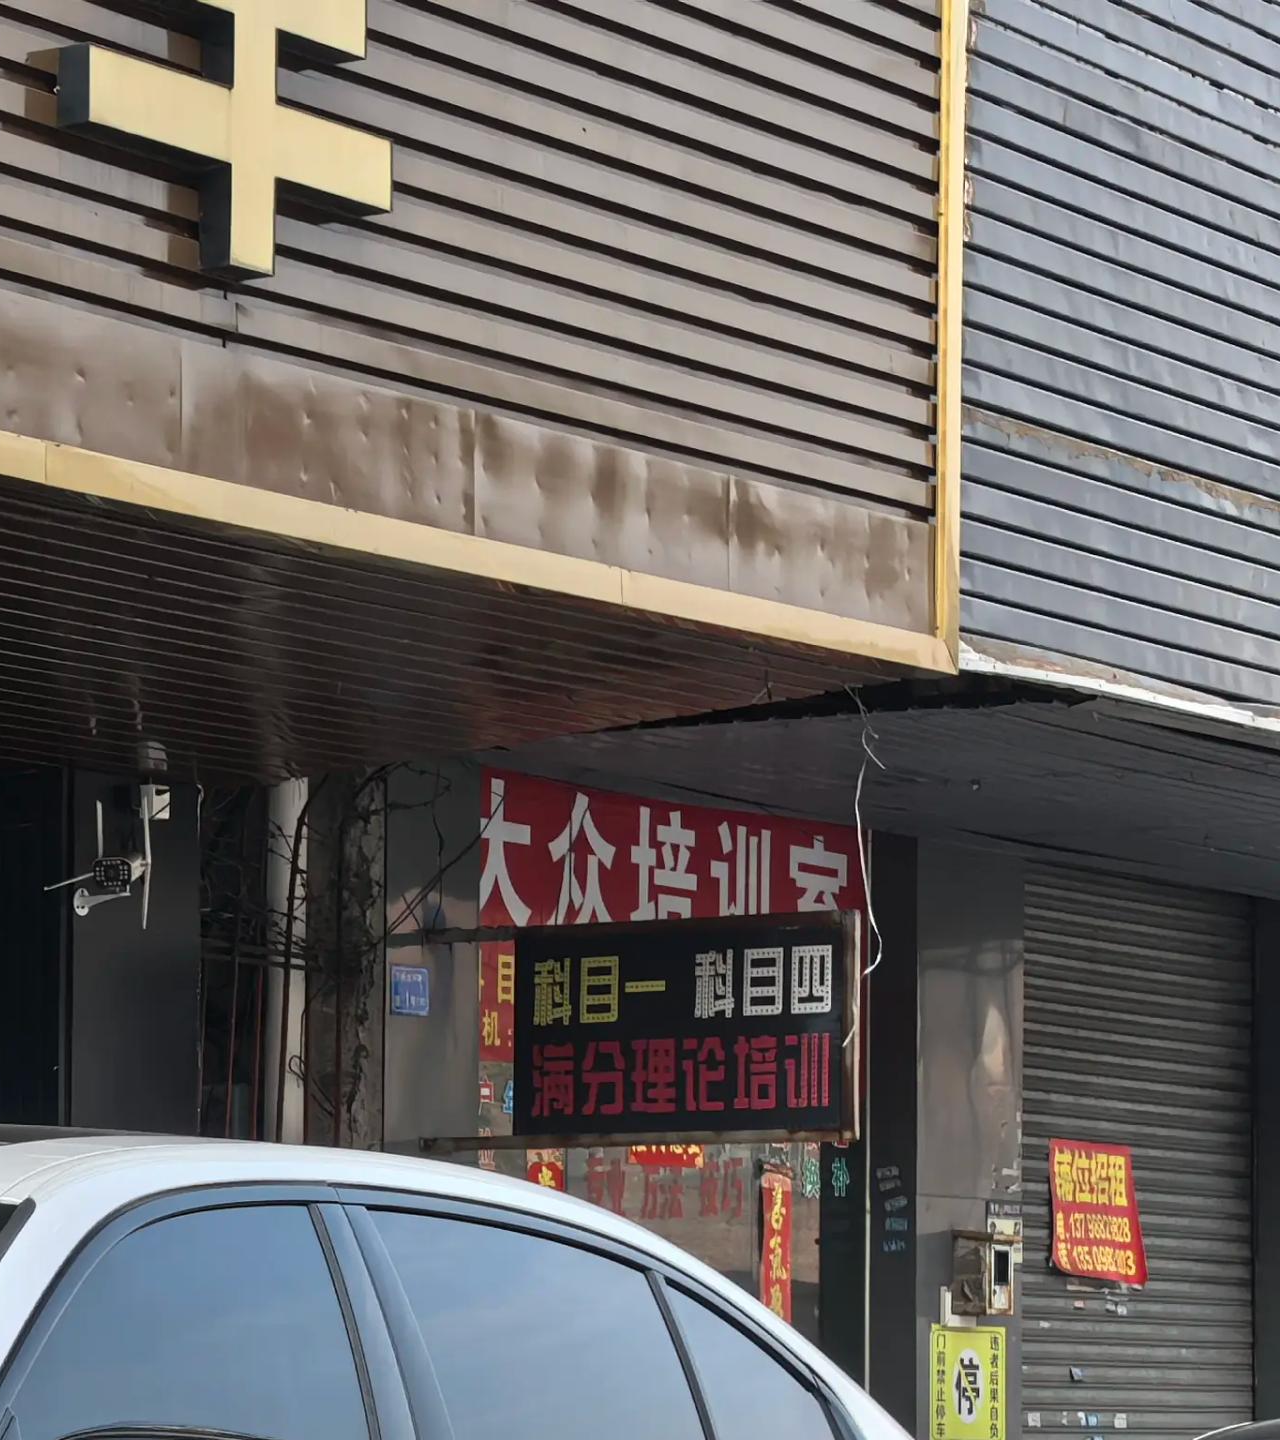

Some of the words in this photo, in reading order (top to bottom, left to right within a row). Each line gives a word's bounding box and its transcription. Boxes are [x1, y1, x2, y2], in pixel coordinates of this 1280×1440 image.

[533, 956, 667, 1026] 科目一
[693, 945, 833, 1018] 科目四
[530, 1032, 831, 1117] 满分理论培训
